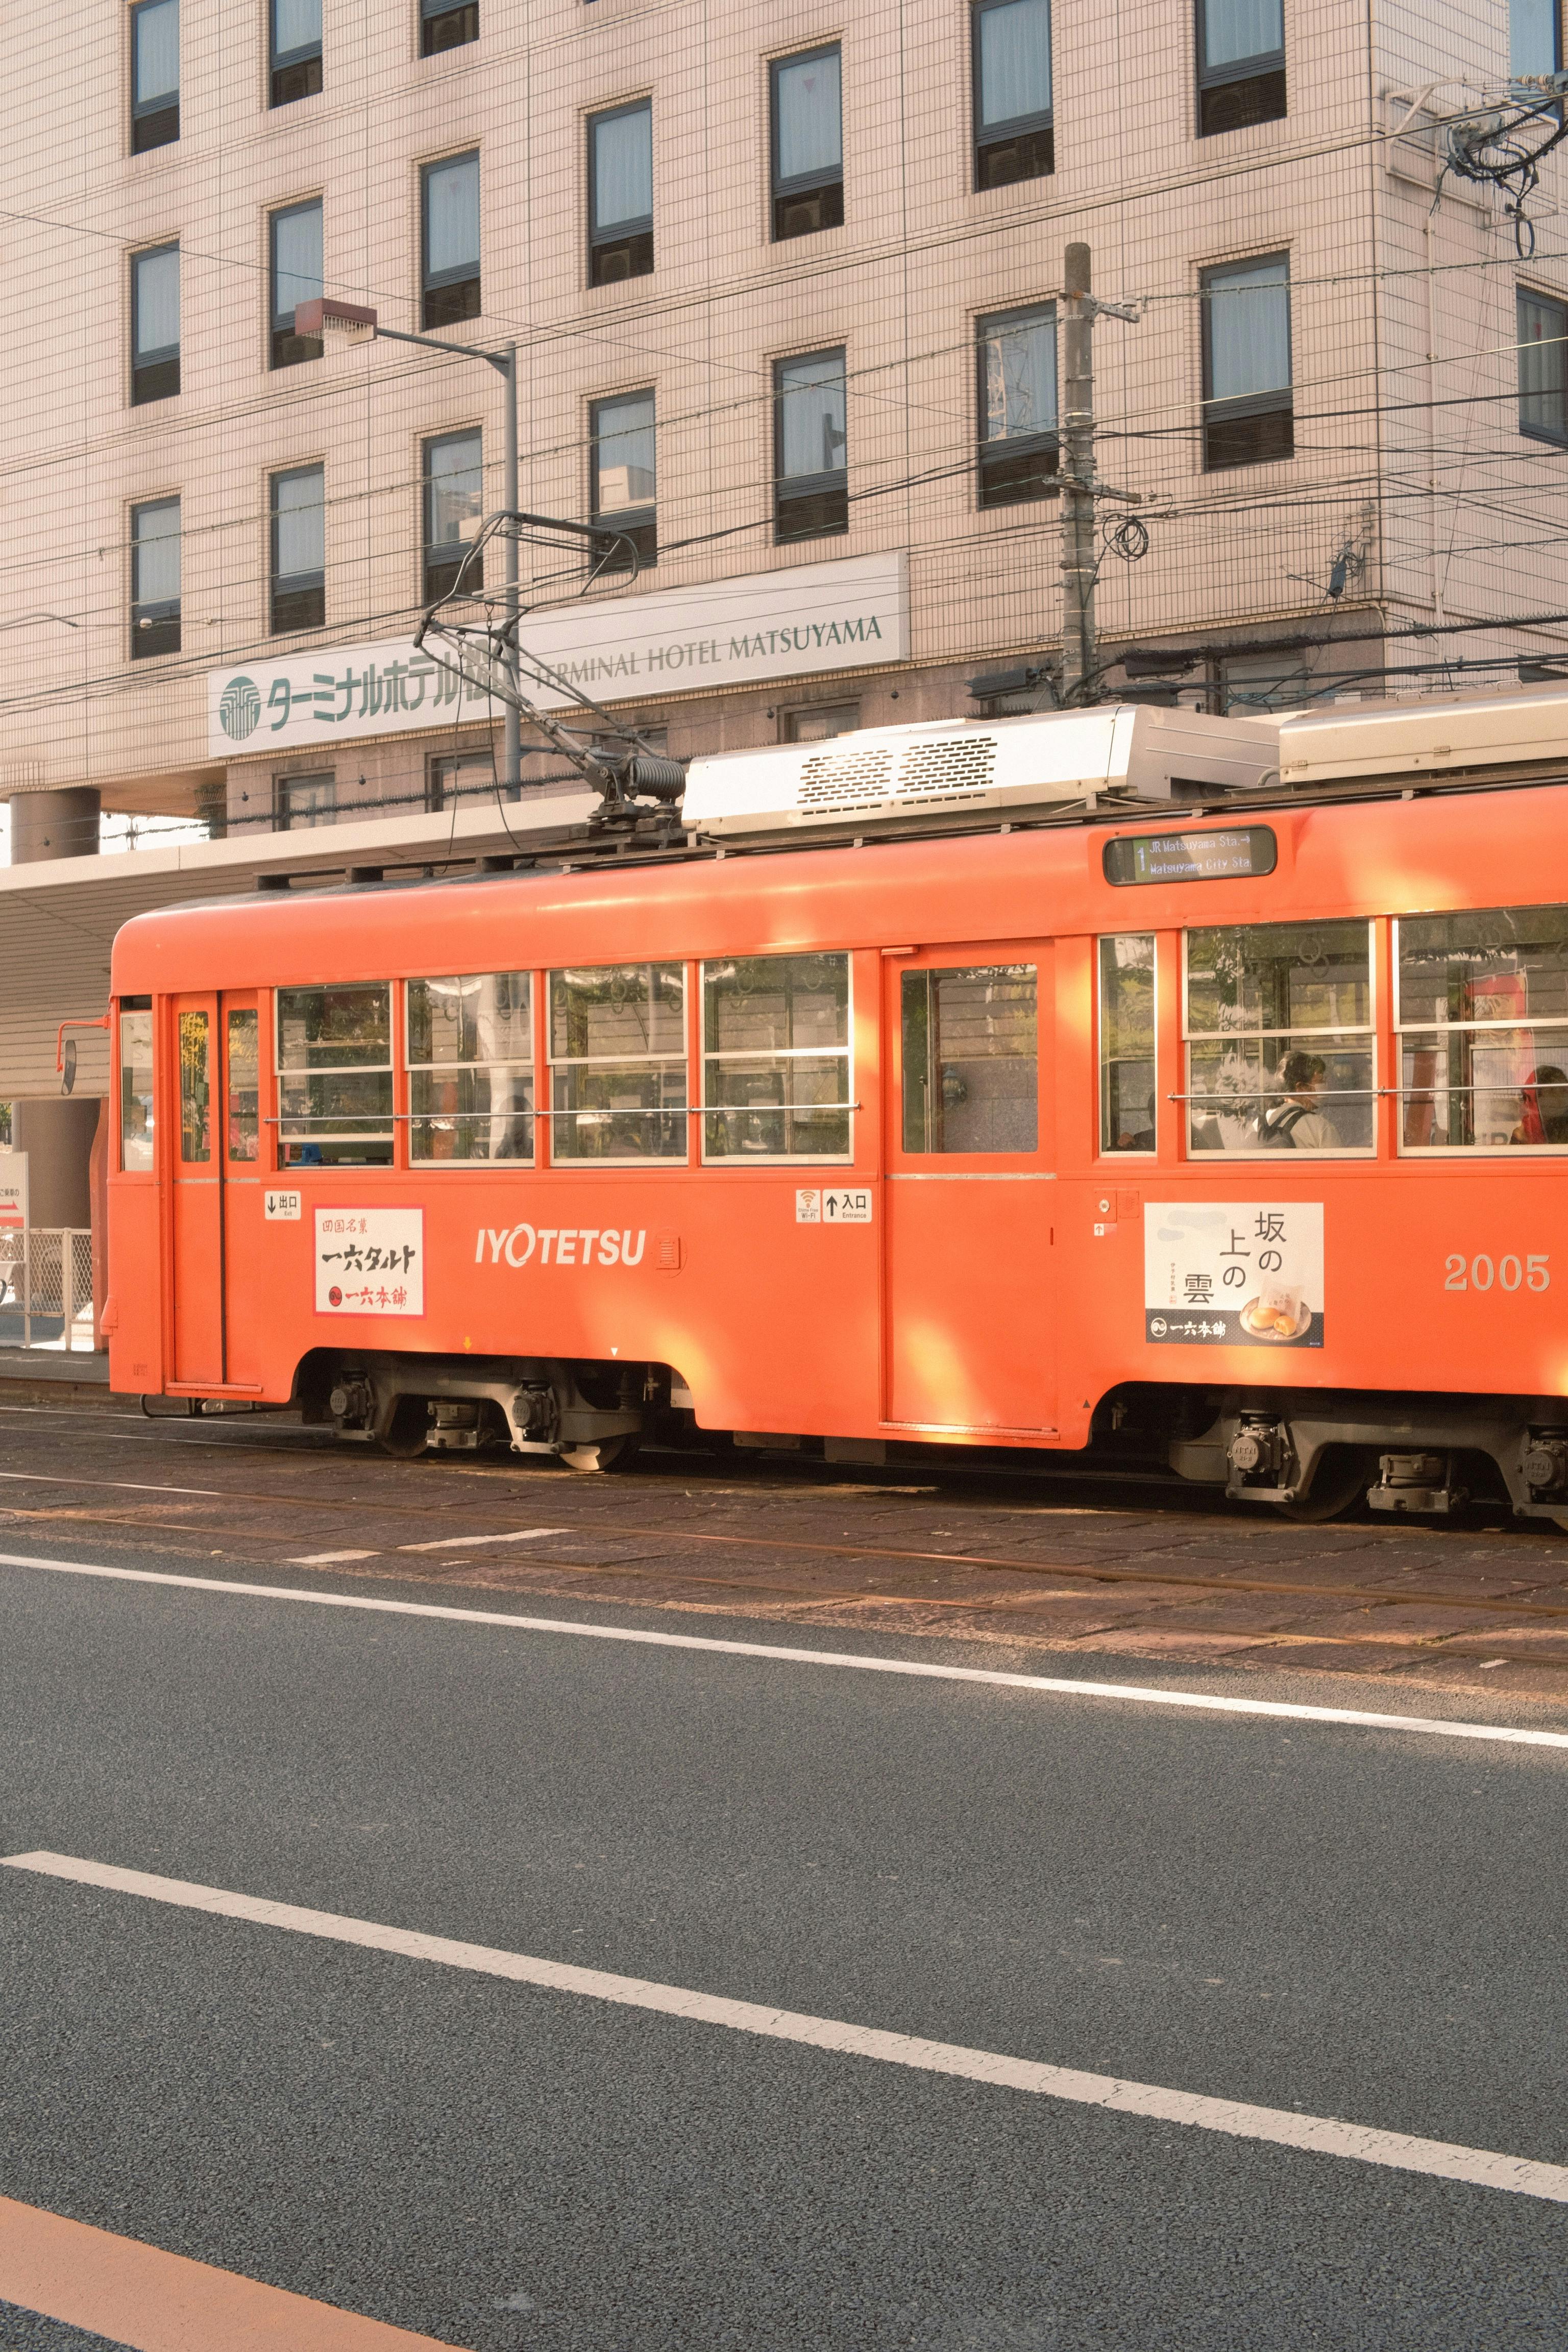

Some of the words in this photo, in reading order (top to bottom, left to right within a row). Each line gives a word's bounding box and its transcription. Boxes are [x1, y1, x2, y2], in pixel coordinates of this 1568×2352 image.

[533, 651, 640, 690] TERMINAL
[649, 639, 721, 673] HOTEL
[729, 615, 882, 661] MATSUYAMA
[1149, 841, 1161, 853] JR
[1164, 839, 1216, 852] Matsuyama
[1219, 836, 1240, 847] Sta.
[1138, 847, 1145, 871] 1
[1150, 862, 1202, 875] Matsuyama
[1206, 859, 1228, 870] City
[1232, 857, 1252, 868] Sta.
[279, 1195, 297, 1209] 出口
[842, 1194, 866, 1209] 入口
[322, 1217, 368, 1234] 四国名菓
[475, 1223, 646, 1268] IYOTETSU
[1255, 1211, 1287, 1272] 坂の
[322, 1244, 415, 1274] 一六タルト
[1219, 1229, 1251, 1288] 上の
[1444, 1254, 1550, 1292] 2005
[345, 1286, 407, 1310] 一六本舗
[1183, 1273, 1214, 1304] 雲
